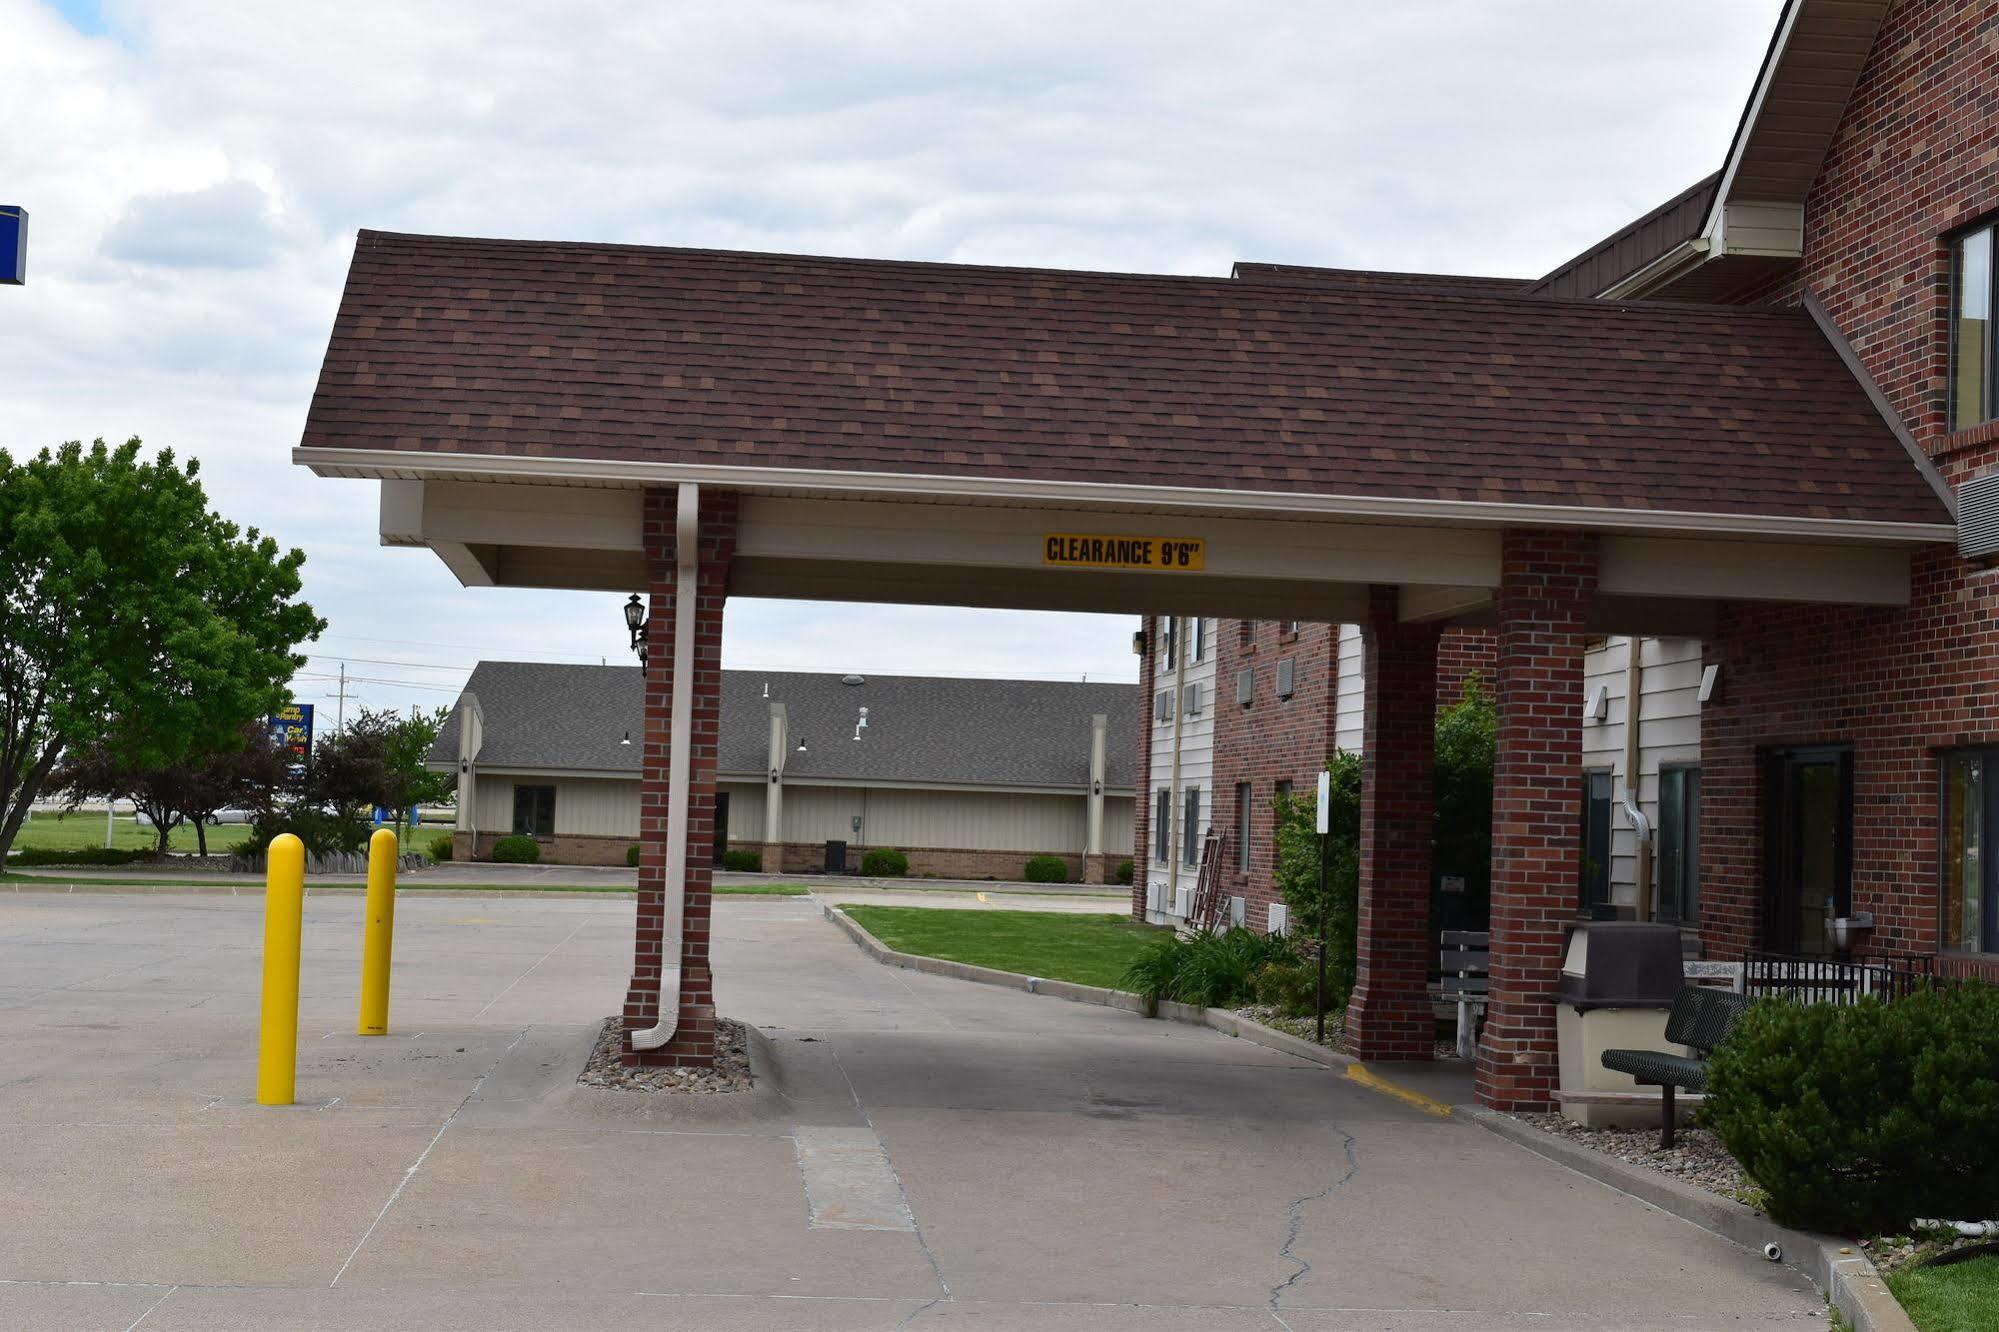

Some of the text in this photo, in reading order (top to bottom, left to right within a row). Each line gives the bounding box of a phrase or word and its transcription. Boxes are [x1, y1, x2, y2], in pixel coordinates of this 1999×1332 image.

[1047, 537, 1152, 565] CLEARANCE
[280, 713, 304, 722] Pantry
[287, 725, 303, 734] Car
